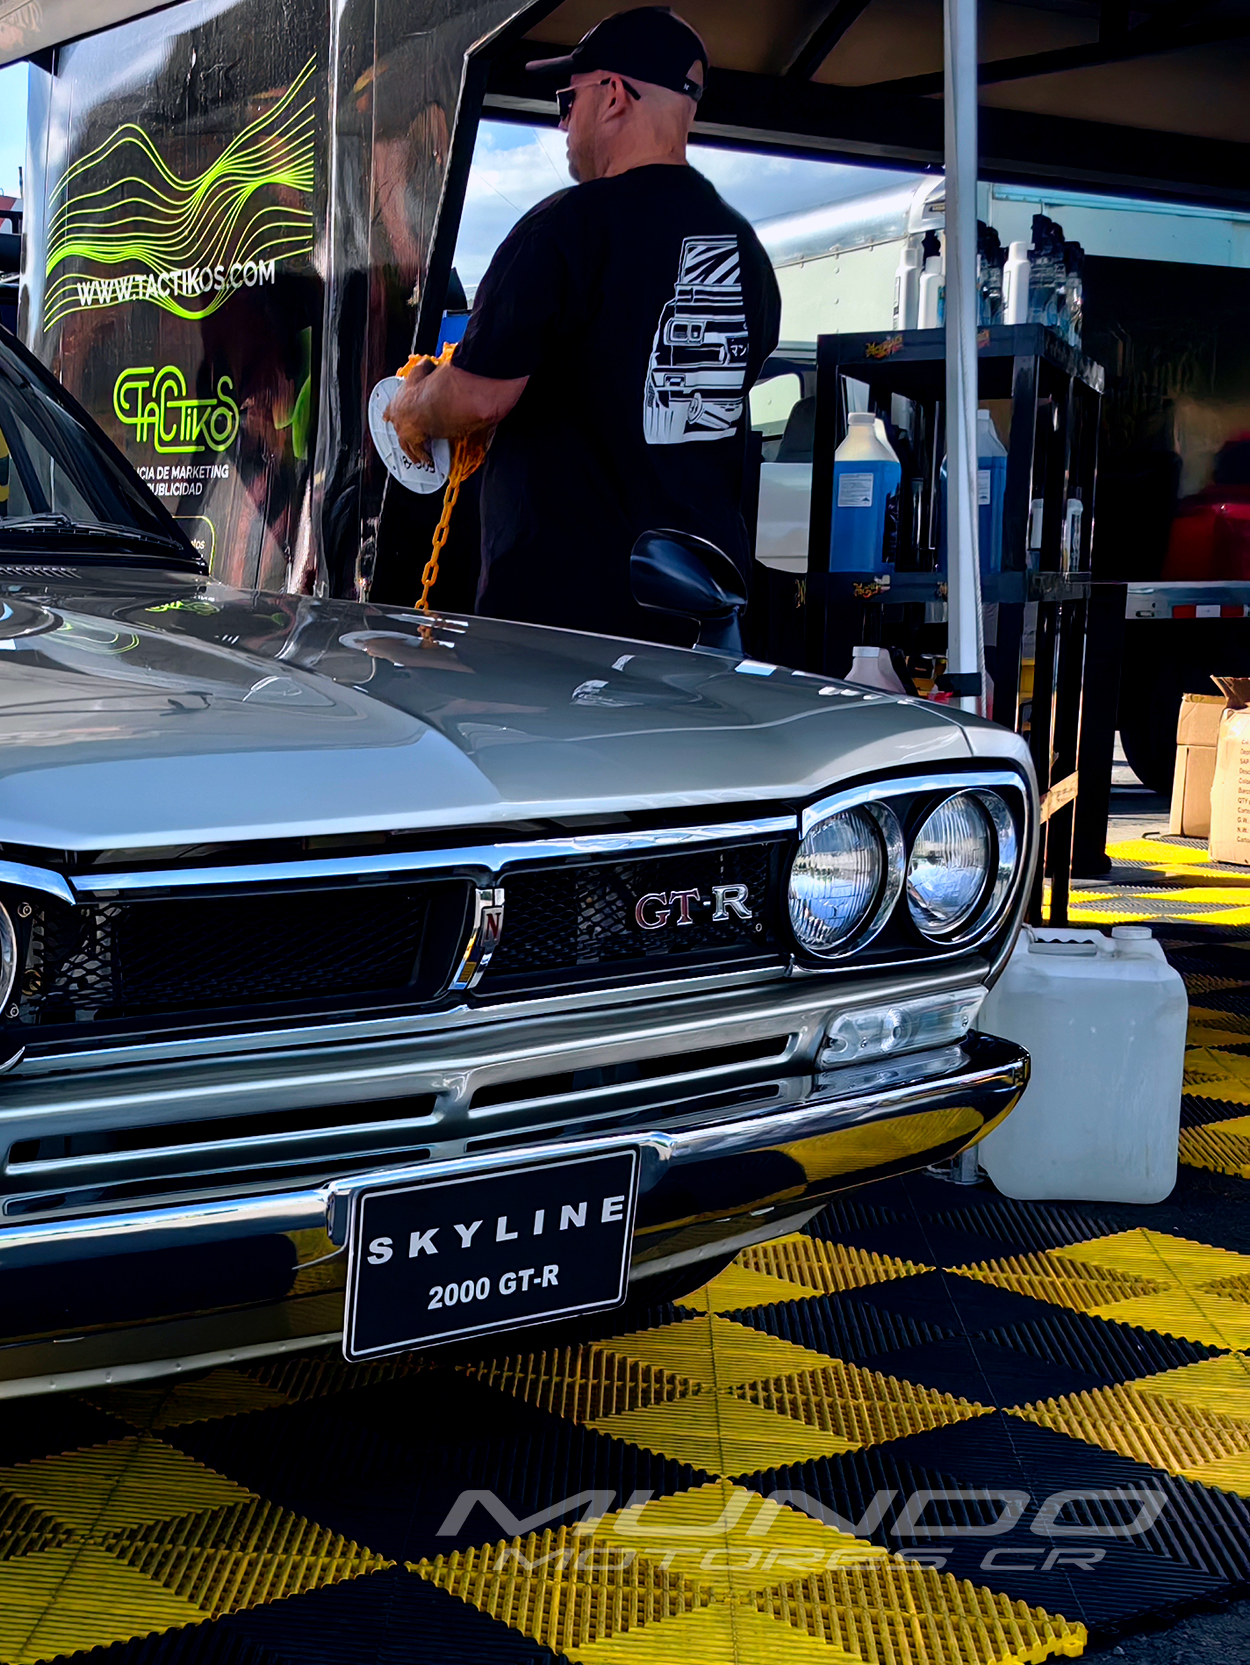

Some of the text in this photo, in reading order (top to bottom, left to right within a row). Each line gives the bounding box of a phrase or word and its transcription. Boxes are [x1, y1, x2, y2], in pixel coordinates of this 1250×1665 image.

[76, 259, 276, 307] WWW.TACTIKOS.COM
[156, 466, 171, 479] DE
[171, 464, 230, 479] MARKETING
[634, 883, 753, 930] GT-R
[366, 1195, 626, 1266] SKYLINE
[426, 1264, 560, 1311] 2000 GT-R
